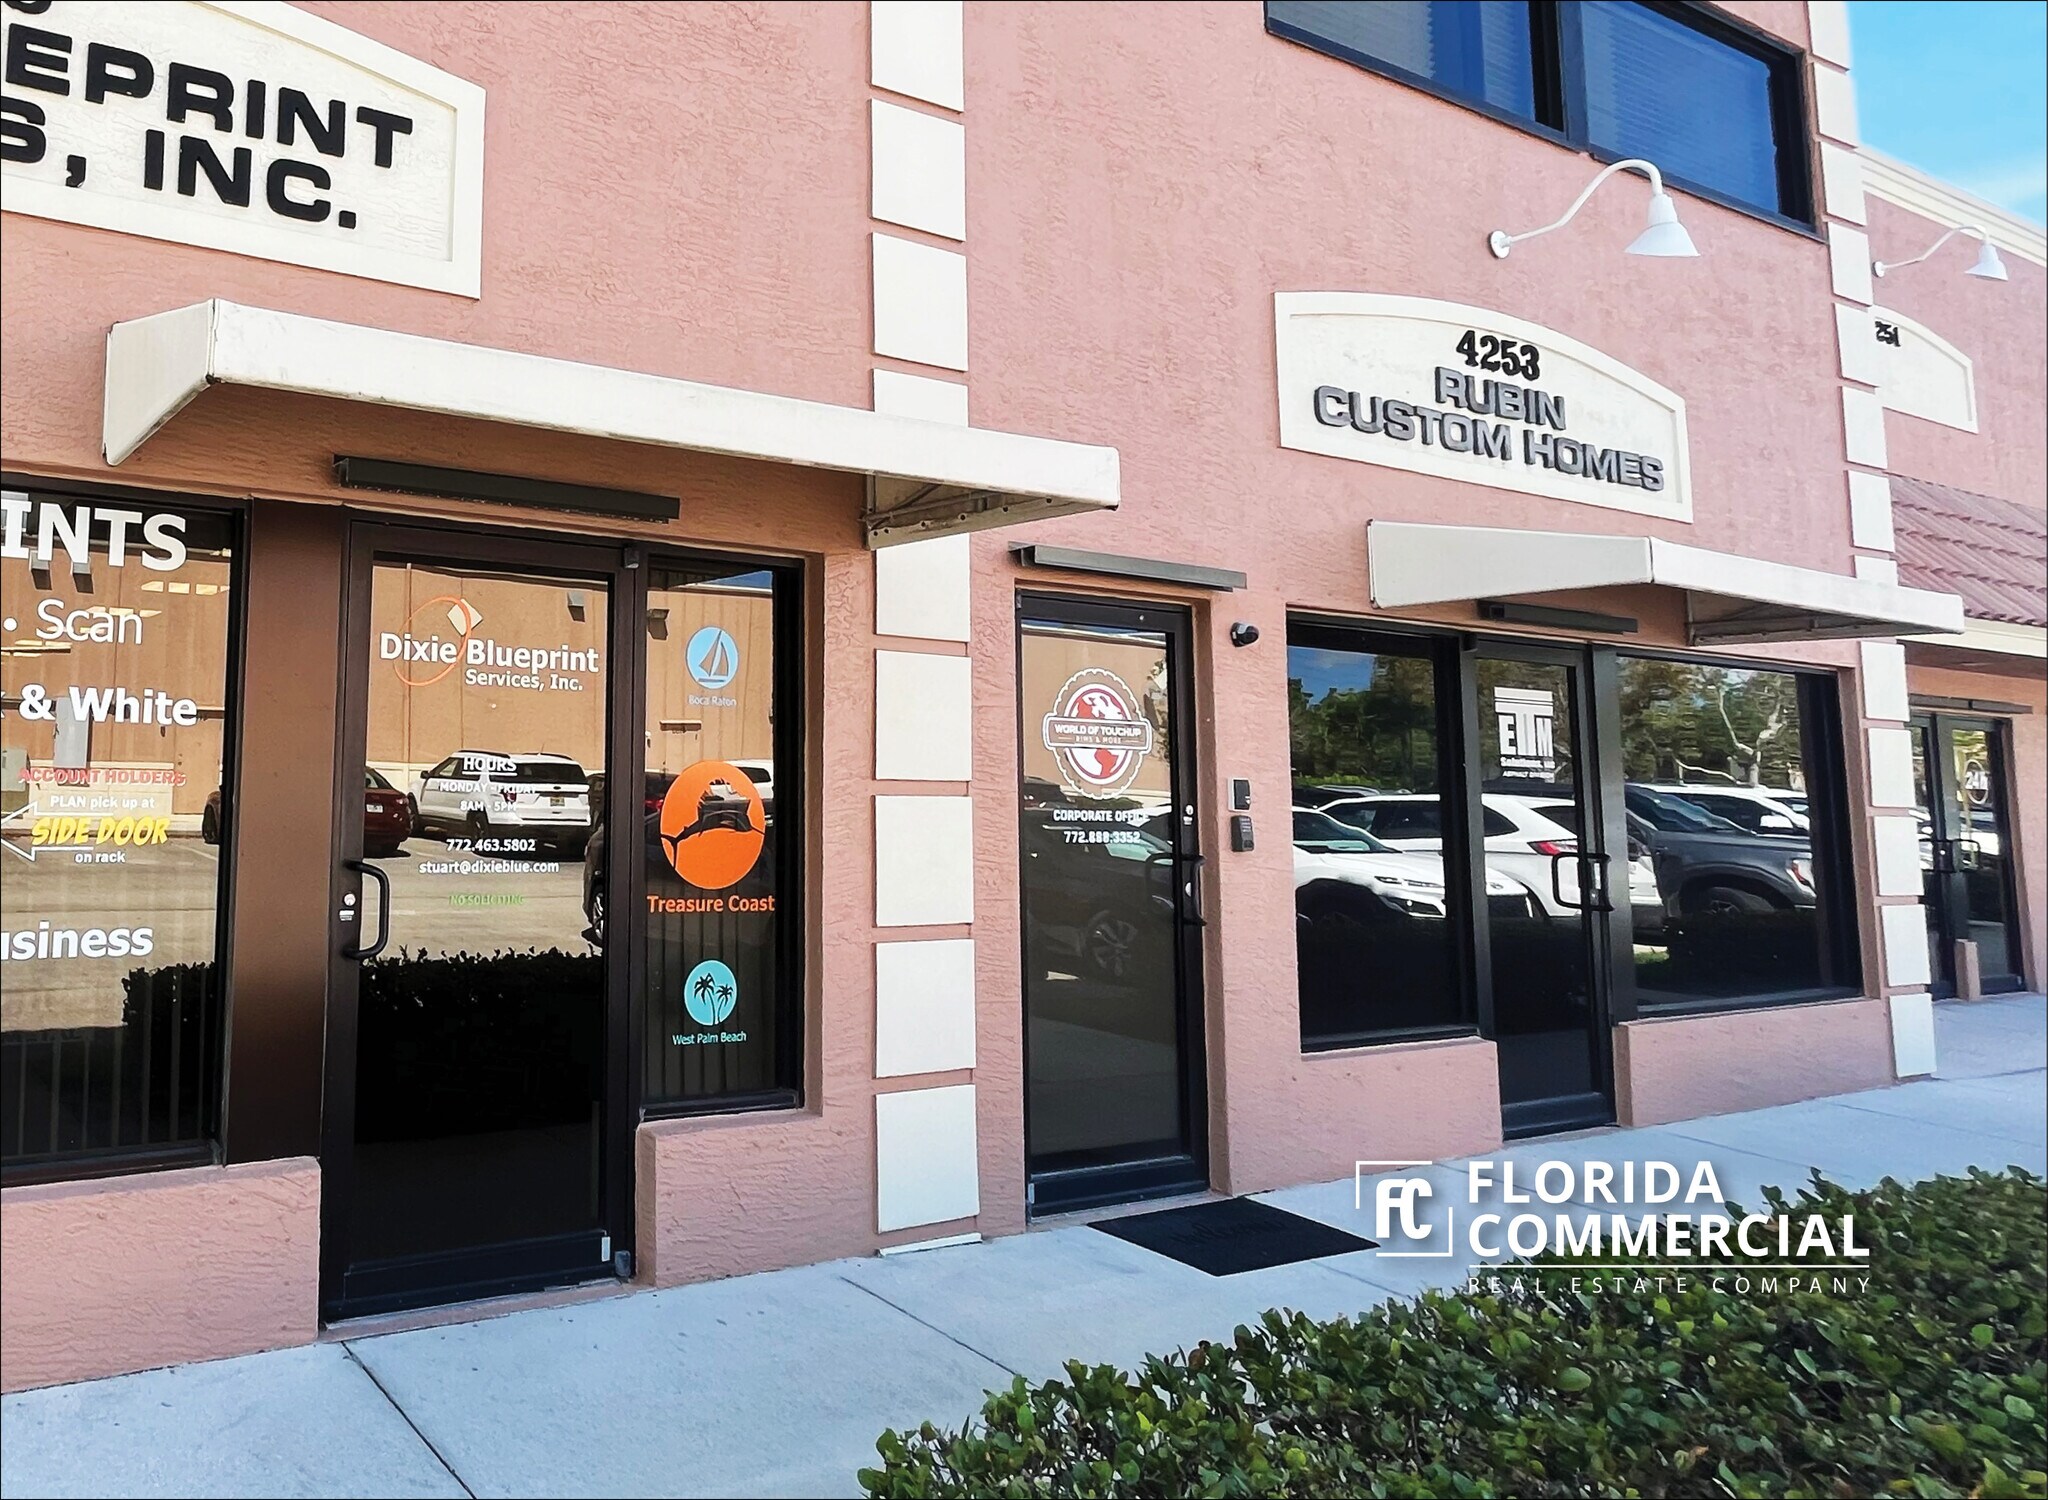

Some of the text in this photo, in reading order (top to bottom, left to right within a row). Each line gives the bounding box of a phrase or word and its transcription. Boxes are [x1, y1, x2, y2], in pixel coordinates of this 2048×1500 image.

[144, 129, 356, 229] INC.
[1456, 330, 1540, 381] 4253
[1435, 367, 1566, 430] RUBIN
[1314, 386, 1664, 491] CUSTOM HOMES
[1, 500, 187, 571] INTS
[36, 599, 143, 644] Scan
[380, 632, 599, 674] Dixie Blueprint
[465, 669, 583, 691] Services, Inc.
[19, 684, 198, 726] & White
[688, 694, 737, 706] Boca Raton
[1055, 724, 1141, 736] WORLD OF TOUCHUP
[463, 757, 517, 771] HOURS
[18, 768, 187, 787] ACCOUNT HOLDERS
[440, 782, 488, 793] MONDAY
[498, 783, 537, 794] FRIDAY
[50, 796, 155, 811] PLAN pick up at
[460, 801, 484, 811] 8AM
[494, 802, 517, 811] 5PM
[1053, 809, 1149, 822] CORPORATE OFFICE
[31, 815, 171, 846] SIDE DOOR
[446, 838, 536, 851] 772.463.5802
[75, 851, 126, 863] on rack
[419, 859, 560, 875] stuart@dixieblue.com
[647, 894, 776, 913] Treasure Coast
[672, 1031, 747, 1045] West Palm Beach
